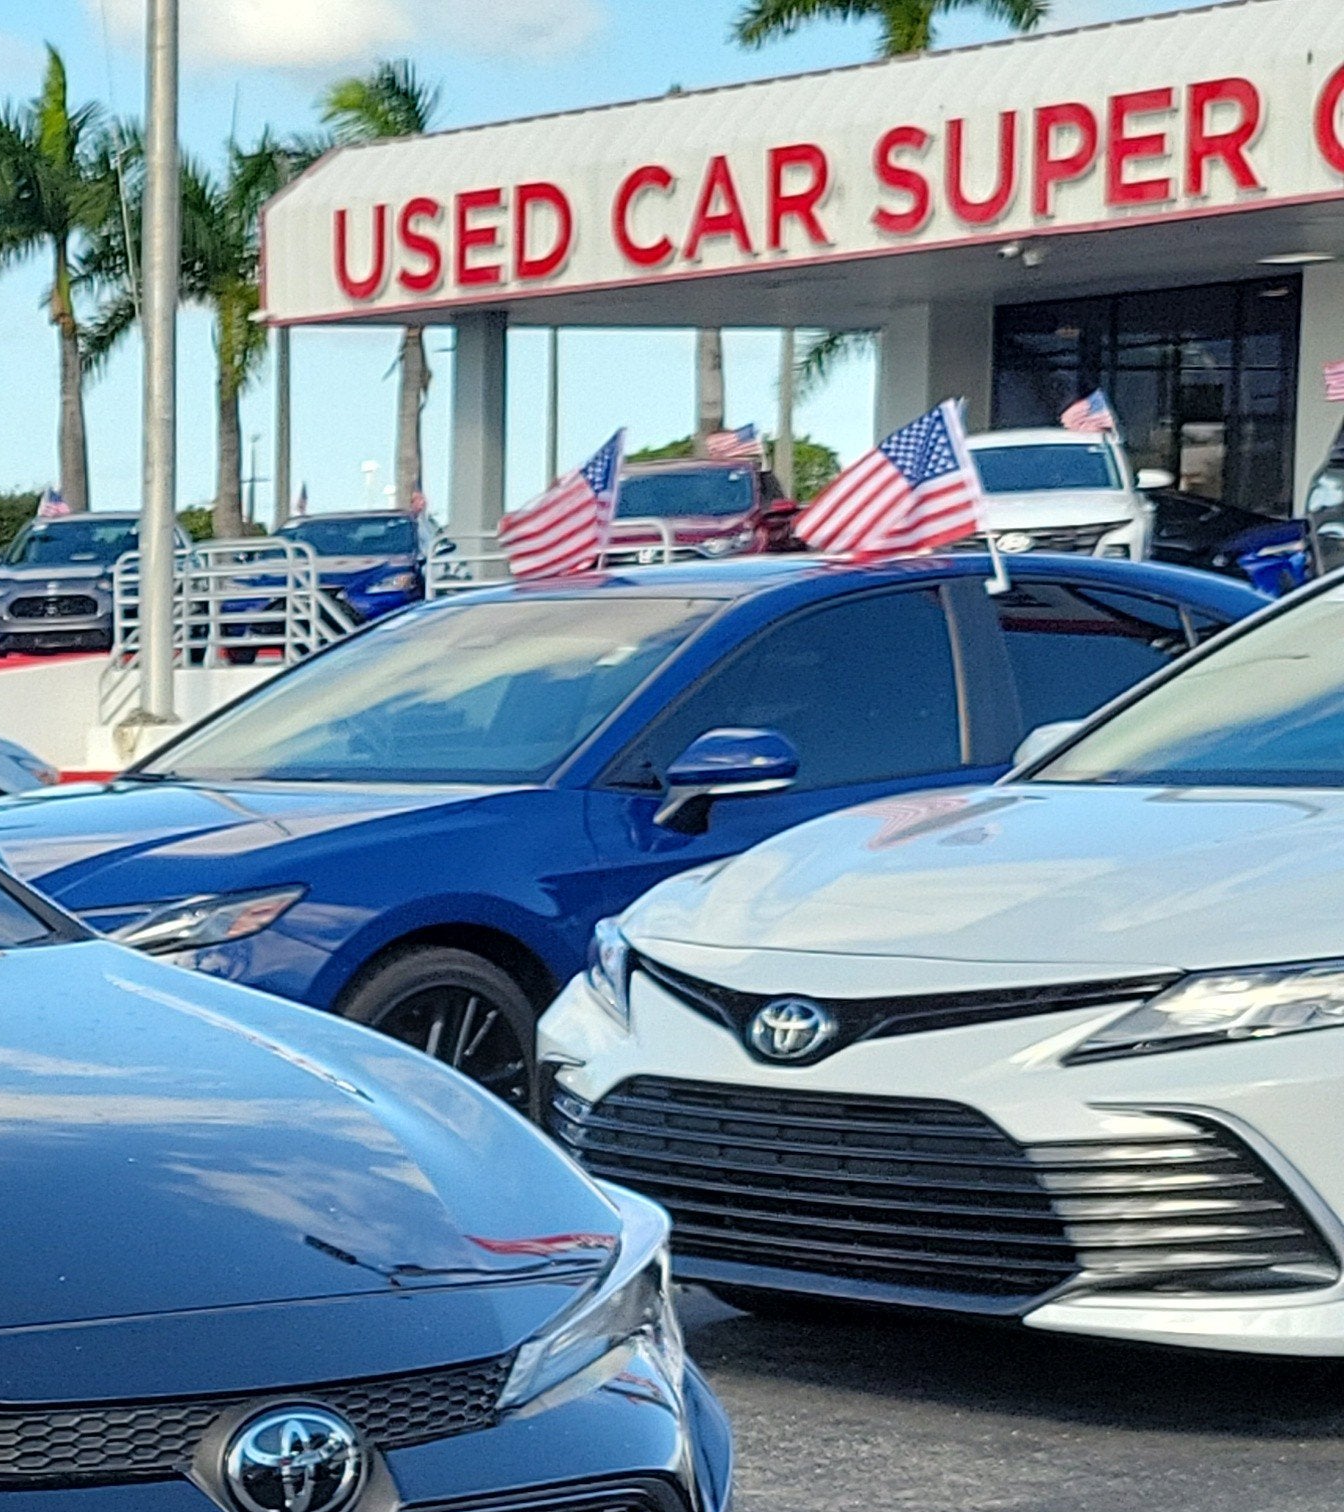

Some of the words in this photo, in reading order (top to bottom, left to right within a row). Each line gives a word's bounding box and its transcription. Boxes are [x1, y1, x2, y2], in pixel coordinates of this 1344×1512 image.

[333, 181, 573, 299] USED
[613, 143, 830, 266] CAR
[870, 76, 1262, 234] SUPER
